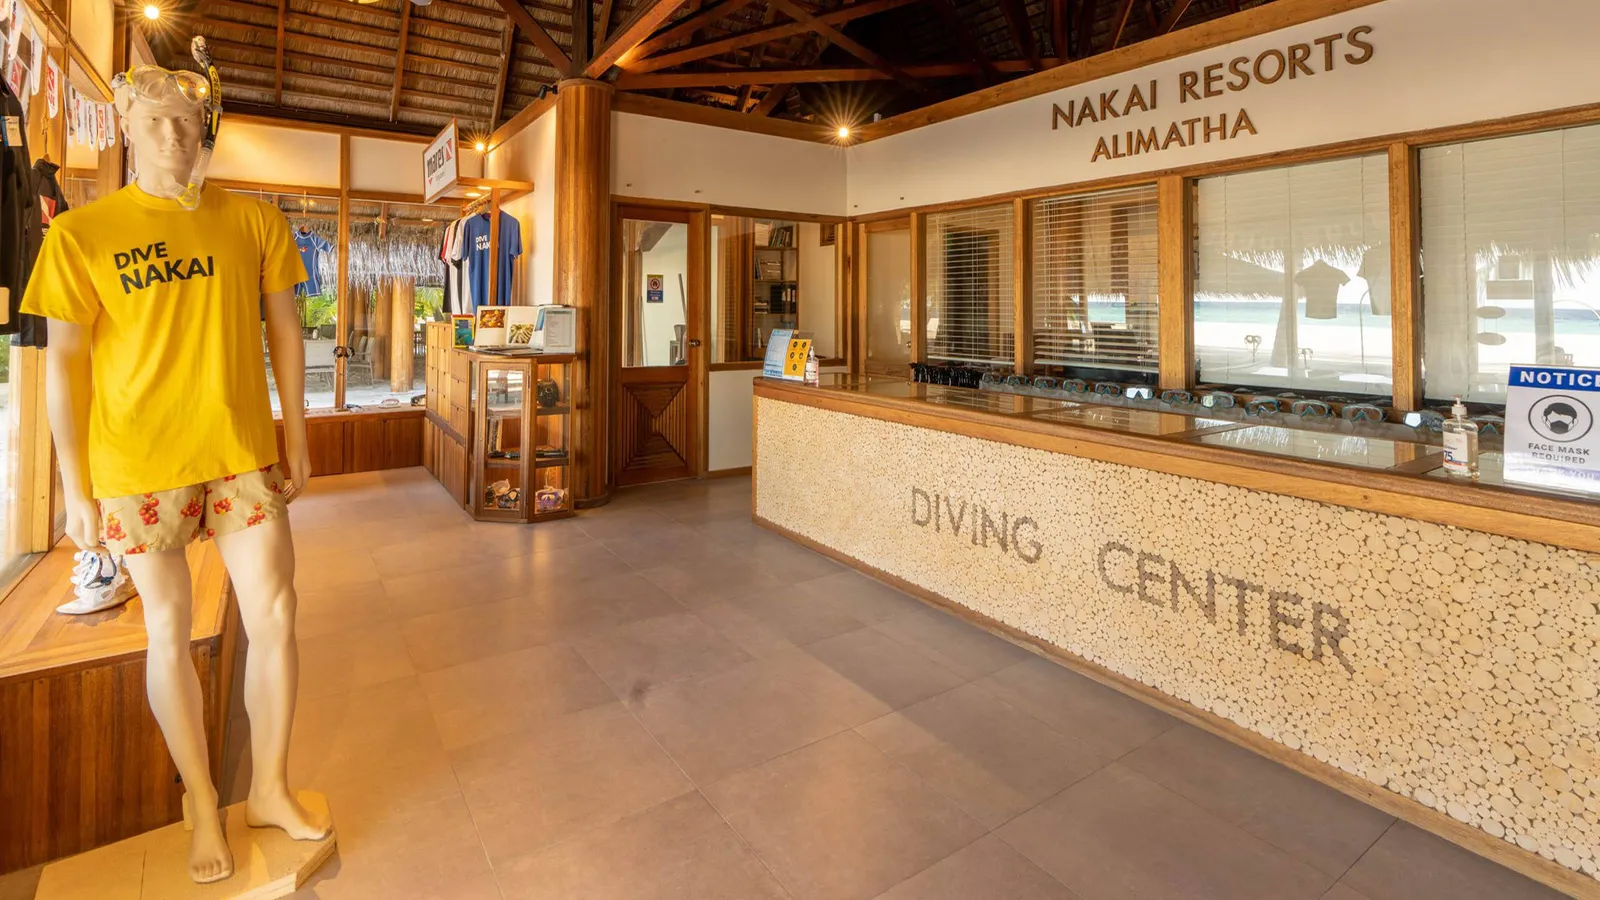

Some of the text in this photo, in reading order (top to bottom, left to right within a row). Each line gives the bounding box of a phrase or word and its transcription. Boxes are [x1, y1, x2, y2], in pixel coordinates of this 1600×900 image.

[1052, 25, 1374, 130] NAKAI RESORTS
[1090, 107, 1258, 163] ALIMATHA
[427, 146, 445, 178] mares
[475, 234, 488, 244] DIVE
[113, 241, 168, 270] DIVE
[119, 256, 214, 294] NAKAI
[1528, 442, 1590, 456] FACE MASK
[1532, 451, 1585, 464] REQUIRED
[911, 487, 1356, 675] DIVING CENTER
